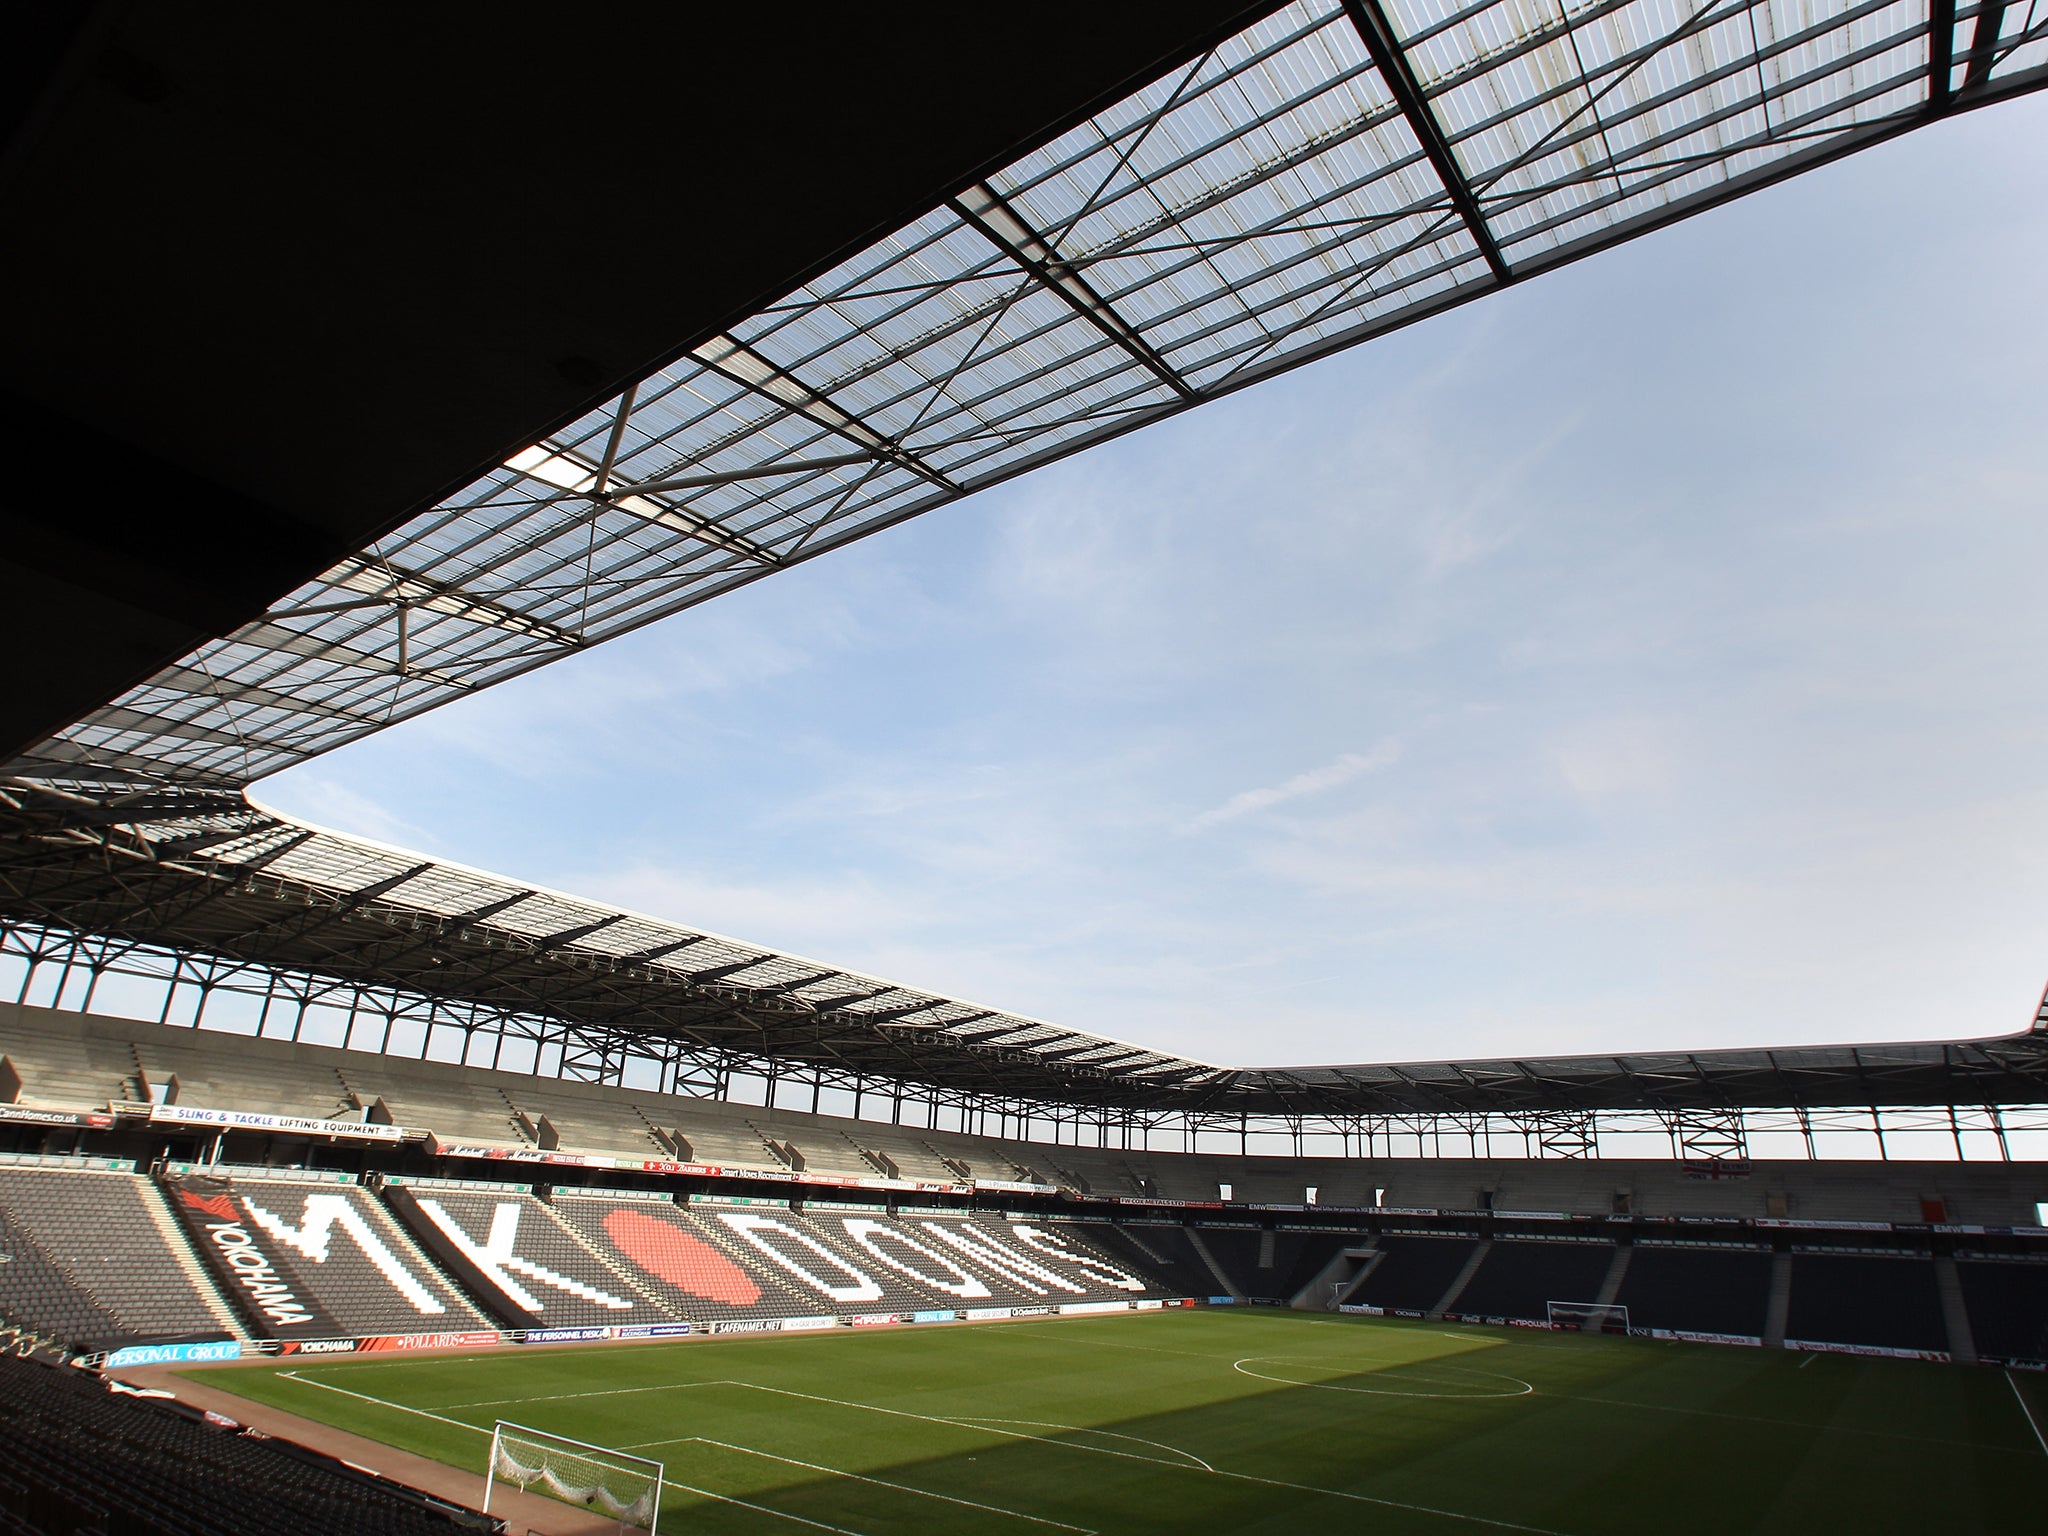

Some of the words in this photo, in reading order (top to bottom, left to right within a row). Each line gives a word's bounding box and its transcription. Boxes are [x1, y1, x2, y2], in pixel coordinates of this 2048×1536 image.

[178, 1109, 213, 1120] SLING
[219, 1113, 227, 1122] &
[234, 1114, 273, 1126] TACKLE
[279, 1119, 319, 1130] LIFTING
[324, 1123, 381, 1135] EQUIPMENT
[205, 1222, 313, 1325] YOKOHAMA
[720, 1321, 781, 1333] SAFENAMES.NET
[300, 1339, 355, 1353] YOKOHAMA
[403, 1334, 460, 1349] POLLARDS
[107, 1347, 182, 1367] PERSONAL
[187, 1345, 238, 1360] GROUP
